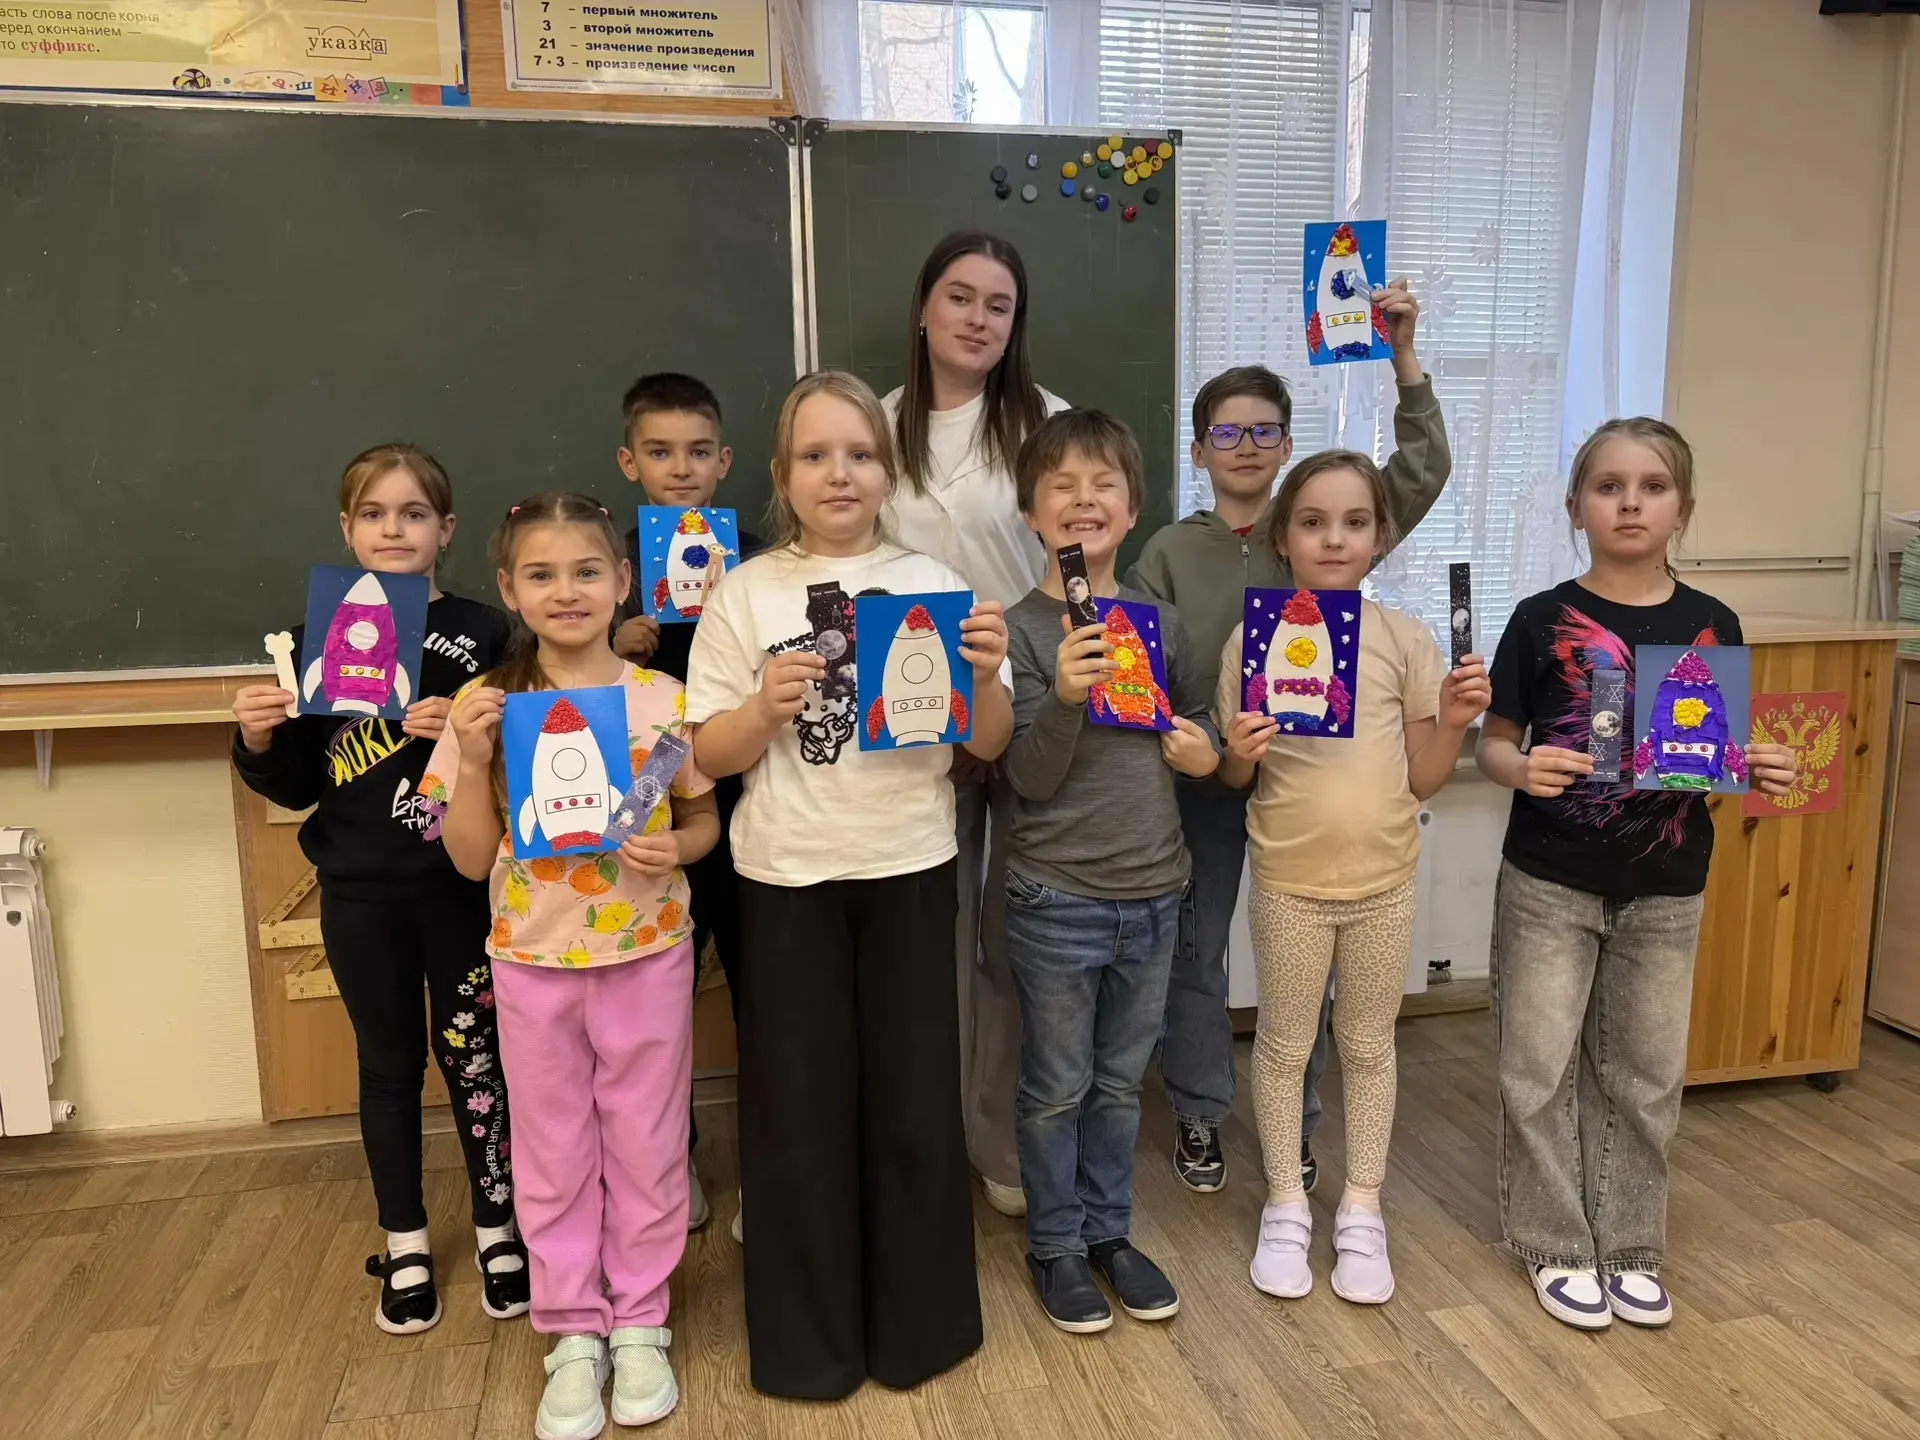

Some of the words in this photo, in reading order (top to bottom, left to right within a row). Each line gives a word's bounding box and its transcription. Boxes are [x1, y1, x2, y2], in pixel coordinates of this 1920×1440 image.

[32, 9, 72, 20] слова
[77, 11, 117, 21] после
[119, 12, 160, 23] корня
[541, 1, 550, 13] 7
[582, 6, 636, 17] первый
[640, 9, 718, 20] множитель
[37, 24, 122, 36] окончанием
[542, 20, 552, 31] 3
[583, 24, 631, 35] второй
[635, 27, 714, 38] множитель
[21, 39, 100, 54] суффикс.
[308, 36, 384, 52] указка
[539, 38, 556, 49] 21
[585, 42, 653, 53] значение
[657, 45, 755, 57] произведения
[586, 59, 689, 71] произведение
[693, 64, 735, 73] чисел
[454, 634, 477, 650] NO
[422, 632, 479, 673] LIMITS
[325, 718, 415, 787] WORL
[488, 1114, 503, 1143] YOUR
[486, 1145, 502, 1180] DREAMS
